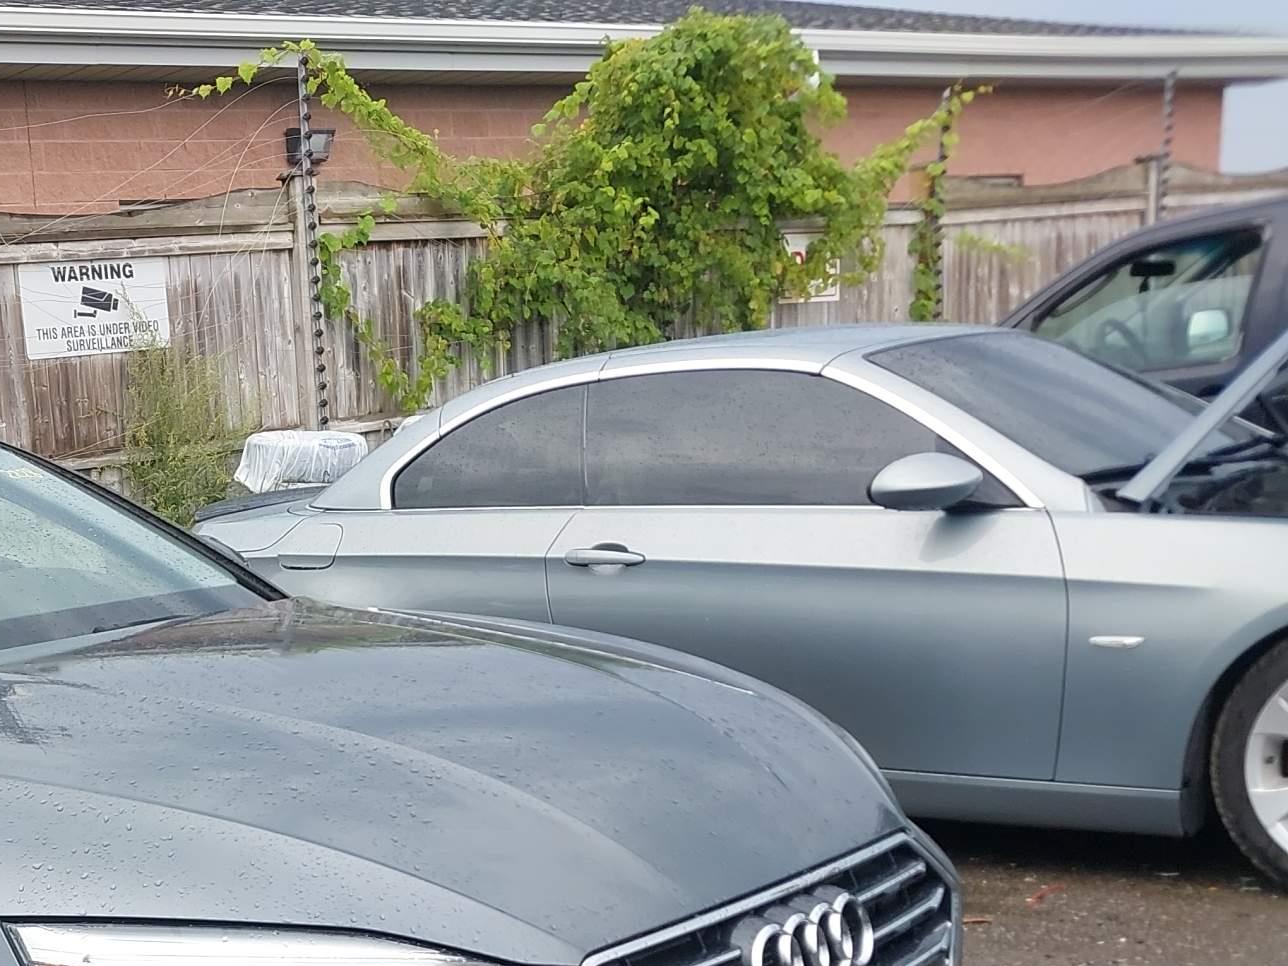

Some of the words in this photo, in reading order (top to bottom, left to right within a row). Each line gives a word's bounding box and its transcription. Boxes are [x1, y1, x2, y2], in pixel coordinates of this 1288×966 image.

[50, 262, 134, 283] WARNING
[36, 327, 58, 341] THIS
[61, 325, 85, 340] AREA
[87, 324, 96, 337] IS
[99, 321, 131, 336] UNDER
[132, 319, 159, 333] VIDEO
[66, 335, 134, 352] SURVEILLANCE
